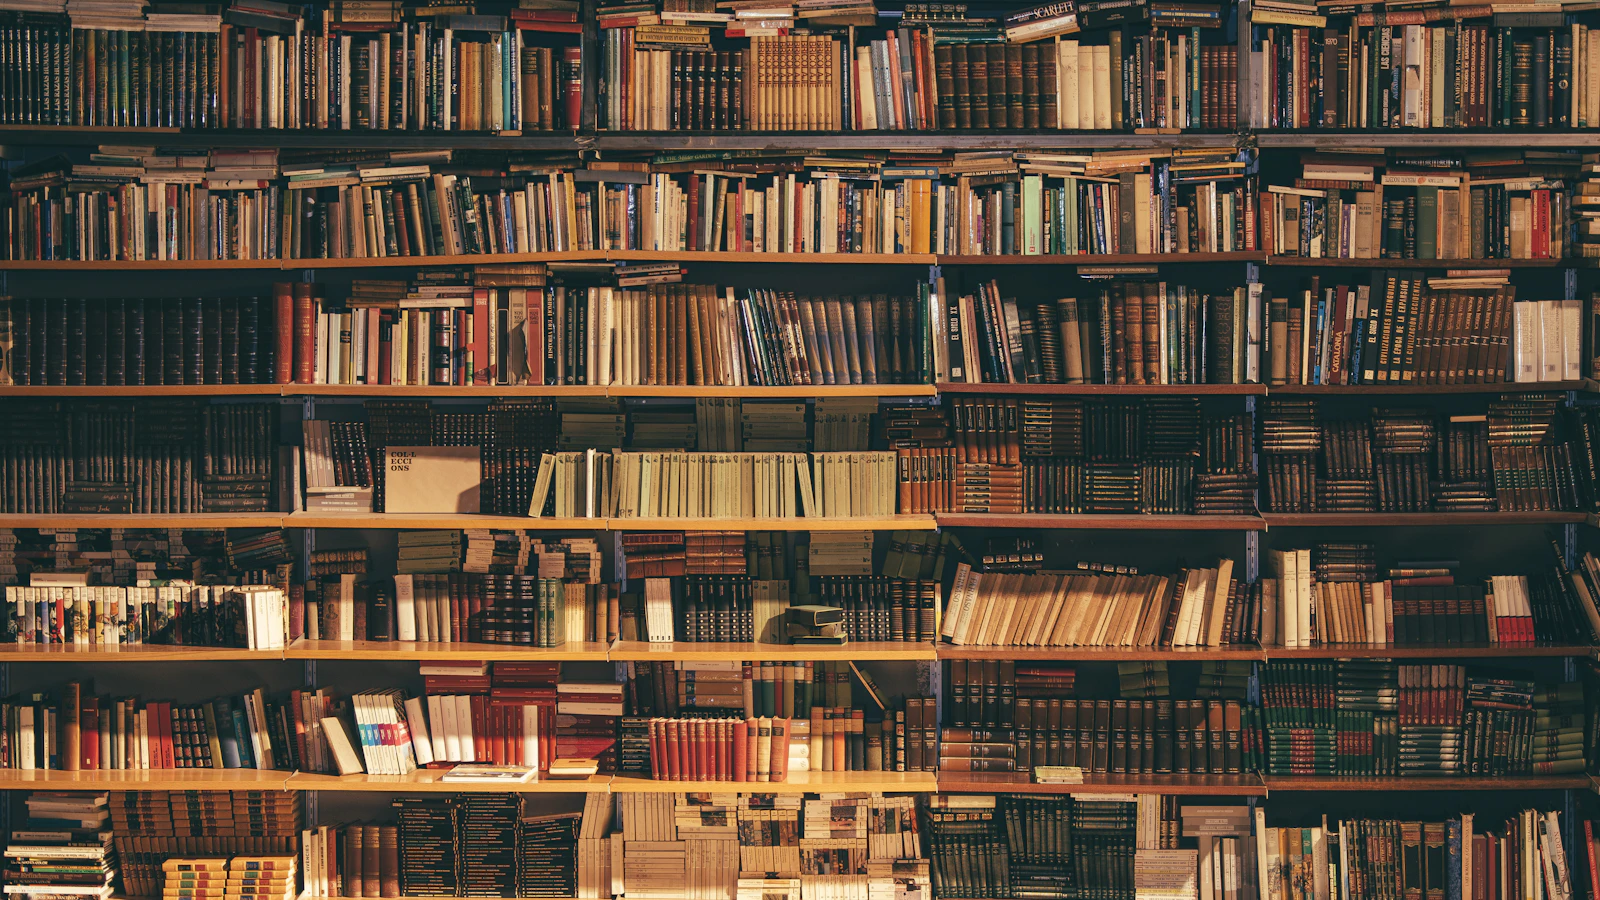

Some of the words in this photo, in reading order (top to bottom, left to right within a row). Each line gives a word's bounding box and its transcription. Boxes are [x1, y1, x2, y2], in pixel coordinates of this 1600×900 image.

[1034, 1, 1074, 20] SCARLETT
[1381, 28, 1390, 56] CIENCIAS
[1381, 57, 1390, 70] LAS
[950, 306, 958, 314] XX
[1385, 278, 1396, 316] EXTINGUIDAS
[1411, 280, 1421, 315] OCCIDENTAL
[1369, 320, 1377, 334] SIGLO
[1370, 309, 1378, 317] XX
[1393, 337, 1402, 354] ÉPOCA
[1398, 280, 1409, 313] EXPANSIÓN
[1354, 321, 1363, 348] LATINA
[1380, 318, 1391, 364] CIVILIZACIONES
[1406, 317, 1417, 355] CIVILIZACIÓN
[1332, 331, 1342, 372] CATALONIA
[963, 577, 977, 611] PARNASO
